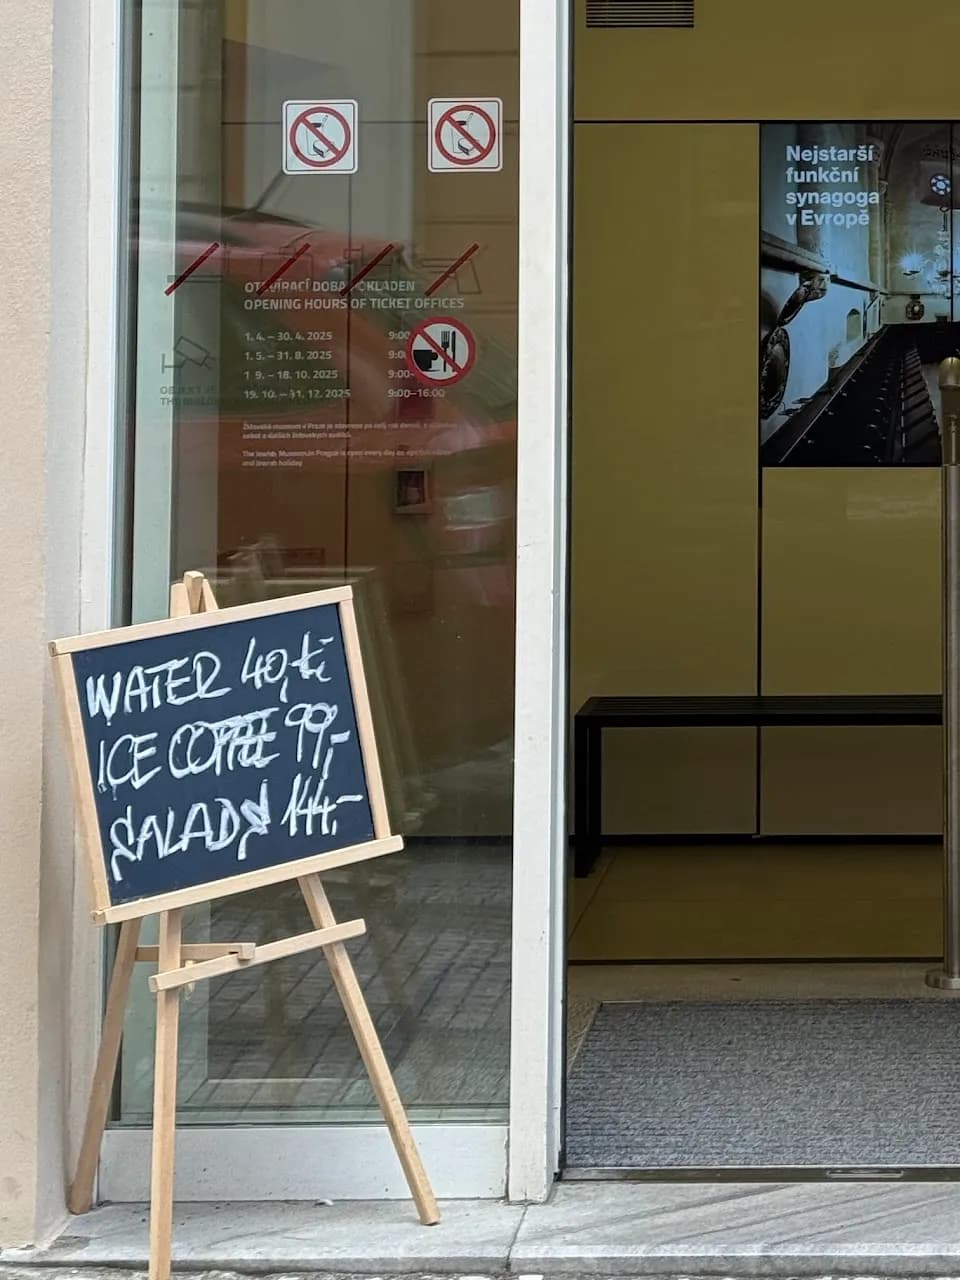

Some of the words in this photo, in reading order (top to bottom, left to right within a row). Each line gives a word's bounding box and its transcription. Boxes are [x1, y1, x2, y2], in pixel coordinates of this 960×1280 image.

[786, 145, 875, 165] Nejstarší
[785, 166, 860, 183] funkční
[785, 191, 880, 208] synagoga
[785, 214, 797, 225] v
[801, 209, 870, 229] Evropě
[351, 280, 415, 292] OKLADEN
[243, 298, 301, 310] OPENING
[304, 298, 348, 310] HOURS
[350, 298, 367, 309] OF
[369, 298, 410, 309] TICKET
[414, 298, 465, 309] OFFICES
[277, 331, 293, 341] 30.
[306, 331, 333, 341] 2025
[277, 351, 292, 360] 31.
[306, 350, 333, 360] 2025
[312, 369, 338, 380] 2025
[325, 389, 352, 399] 2025
[86, 650, 232, 726] WATER
[97, 732, 162, 800] ICE
